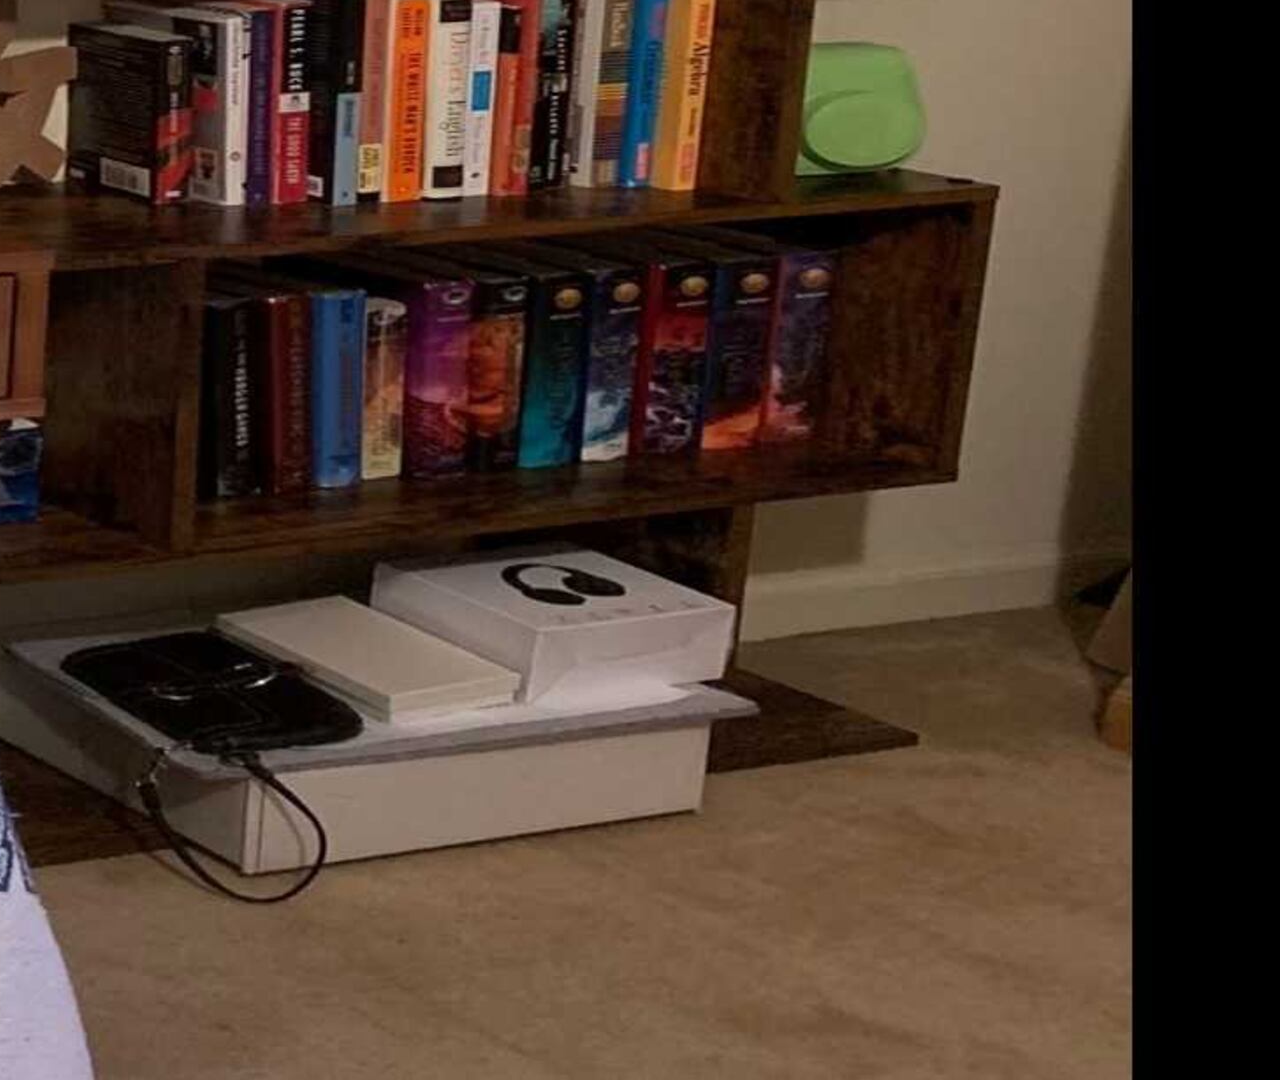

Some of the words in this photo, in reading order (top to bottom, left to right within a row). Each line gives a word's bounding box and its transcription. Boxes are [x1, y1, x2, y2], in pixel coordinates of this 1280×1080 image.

[287, 8, 306, 43] PEARL
[287, 47, 305, 58] S.
[407, 51, 423, 69] THE
[287, 62, 306, 91] BUCK
[687, 41, 712, 98] Algebra
[286, 117, 304, 132] THE
[439, 99, 467, 157] English
